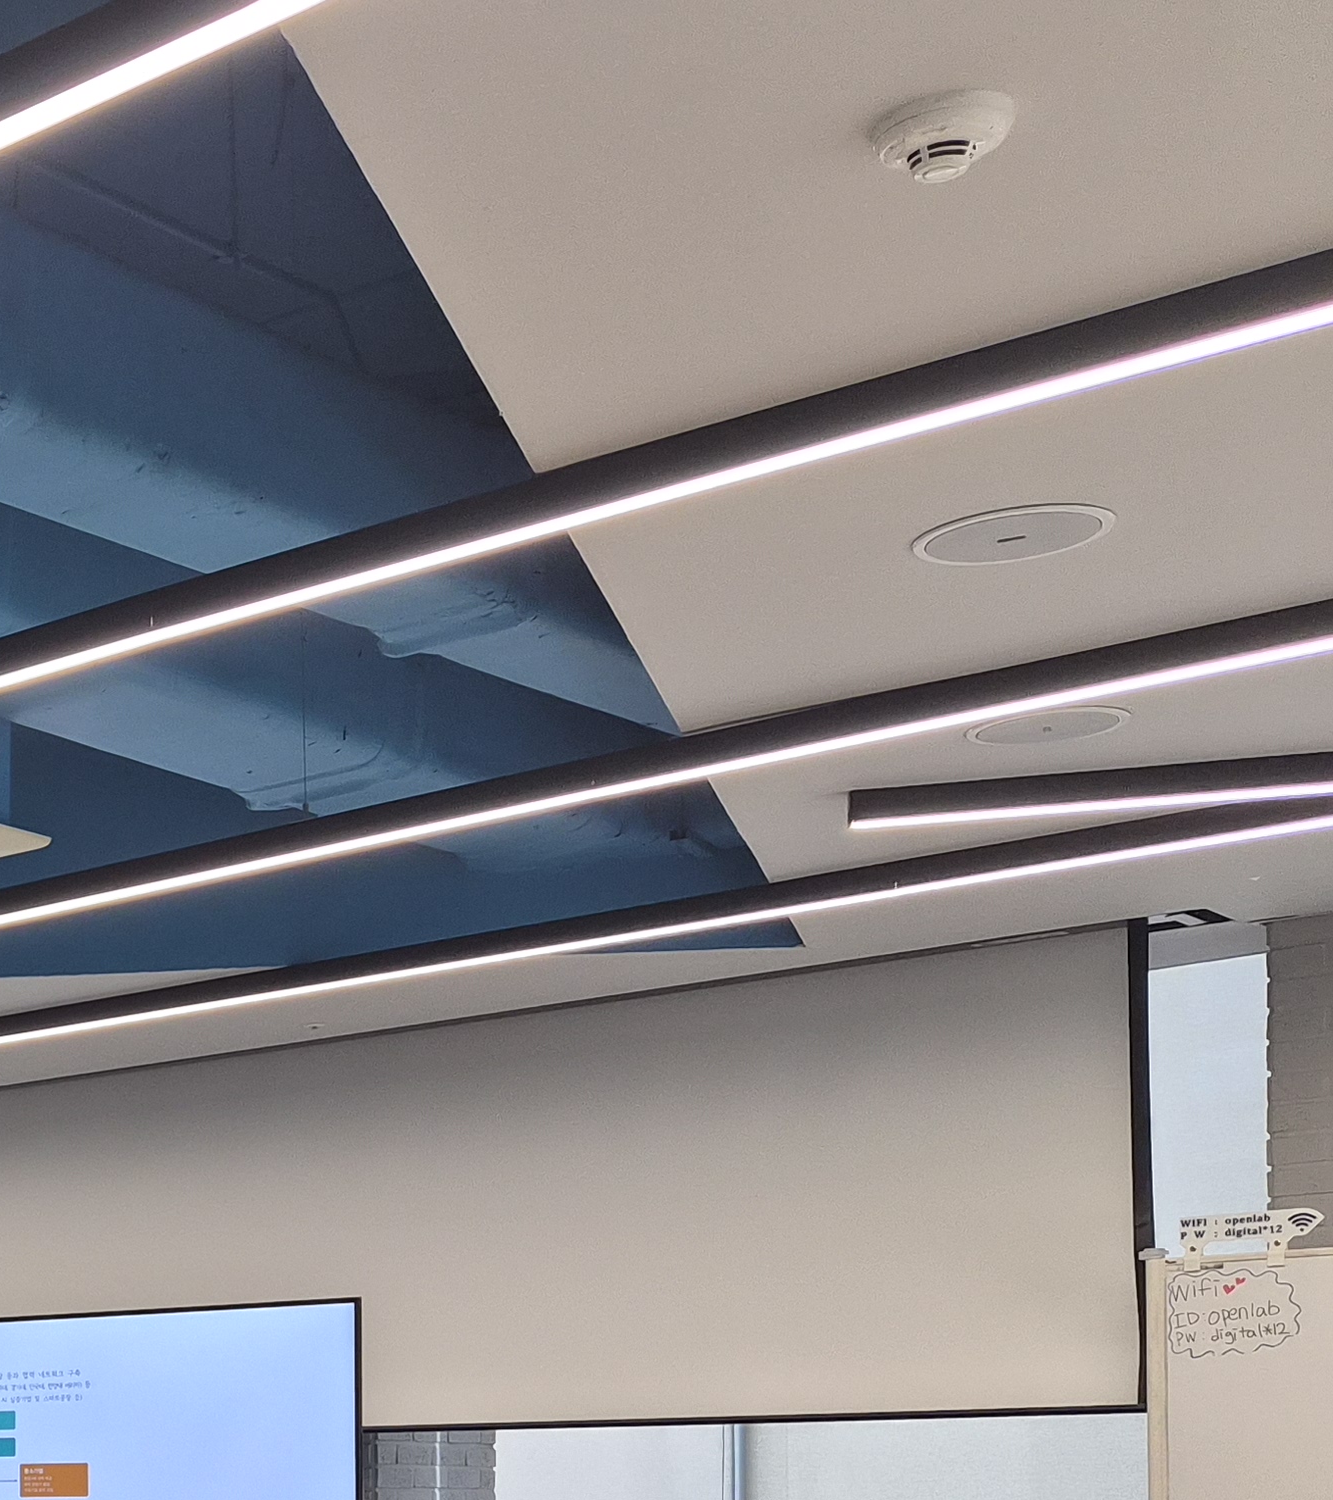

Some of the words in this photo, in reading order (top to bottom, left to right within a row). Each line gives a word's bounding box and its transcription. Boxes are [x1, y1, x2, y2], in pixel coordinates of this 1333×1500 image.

[1180, 1218, 1207, 1228] WIFI
[1224, 1213, 1271, 1227] openlab
[1171, 1278, 1219, 1302] Wifi
